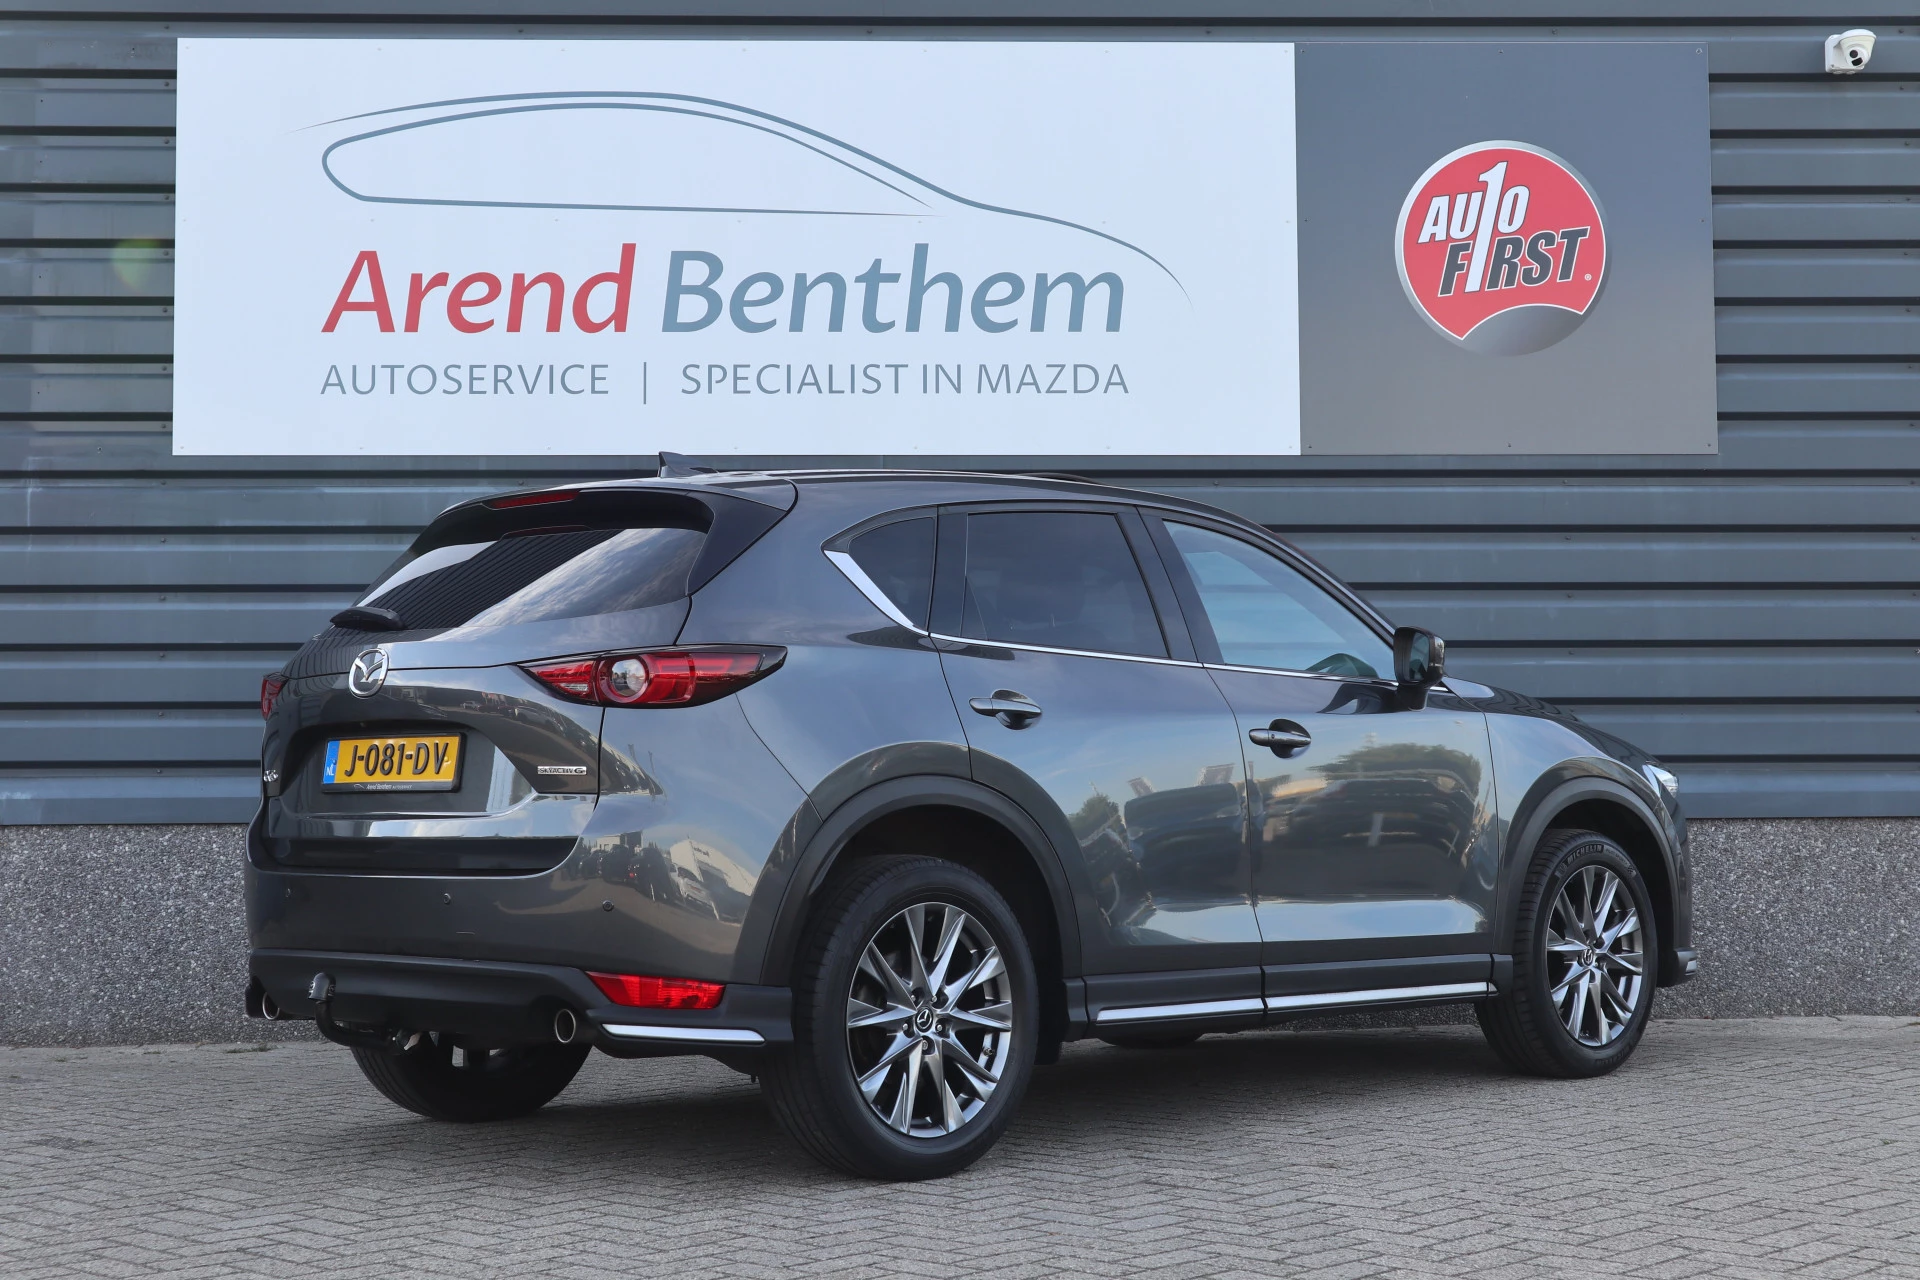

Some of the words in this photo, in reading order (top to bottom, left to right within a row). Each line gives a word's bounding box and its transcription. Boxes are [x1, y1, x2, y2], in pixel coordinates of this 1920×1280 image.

[321, 243, 636, 333] Arend
[662, 243, 1124, 333] Benthem
[321, 364, 609, 395] AUTOSERVICE
[682, 364, 908, 394] SPECIALIST
[922, 364, 962, 394] IN
[977, 364, 1129, 394] MAZDA
[344, 742, 449, 777] J-081-DV
[1567, 844, 1604, 864] MICHELIN
